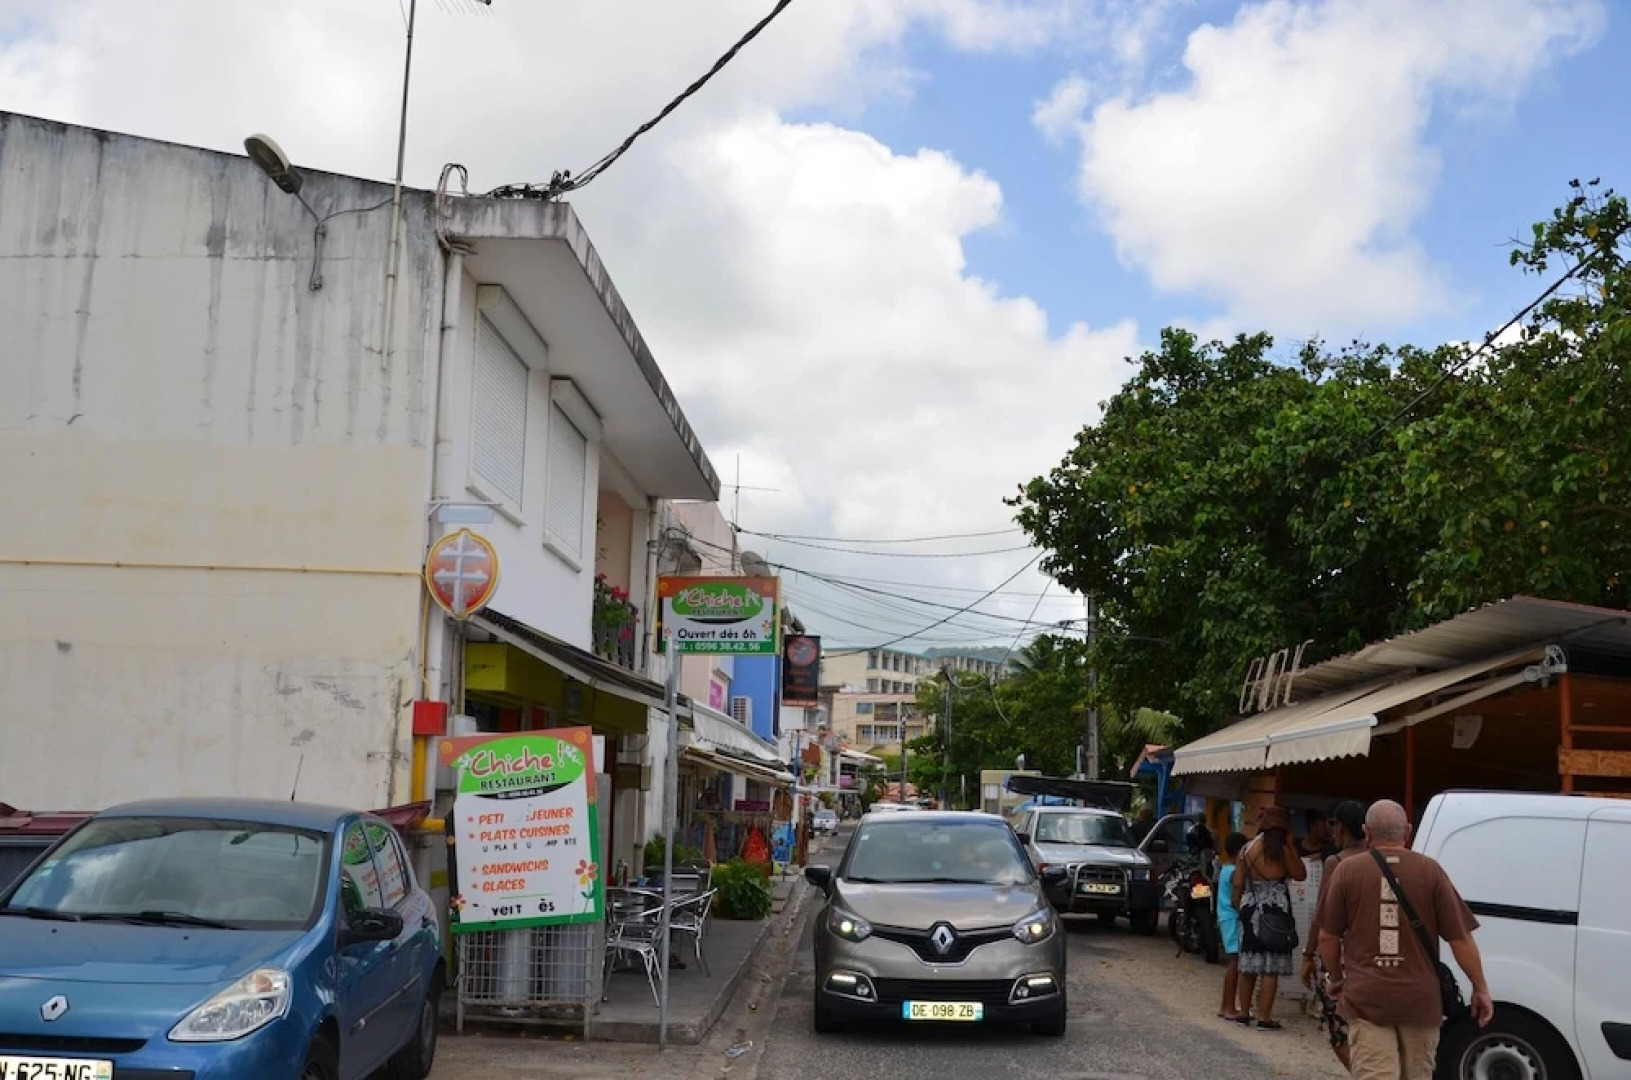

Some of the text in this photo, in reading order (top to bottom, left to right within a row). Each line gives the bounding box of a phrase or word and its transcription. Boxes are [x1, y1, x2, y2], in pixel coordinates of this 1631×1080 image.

[687, 588, 742, 607] Chiche
[678, 628, 757, 638] Ouvert dès 6h
[470, 745, 554, 776] Chiche
[480, 773, 556, 789] RESTAURANT
[480, 823, 570, 842] PLATS CUISINES
[482, 860, 549, 875] SANDWICHS
[482, 879, 526, 892] GLACES
